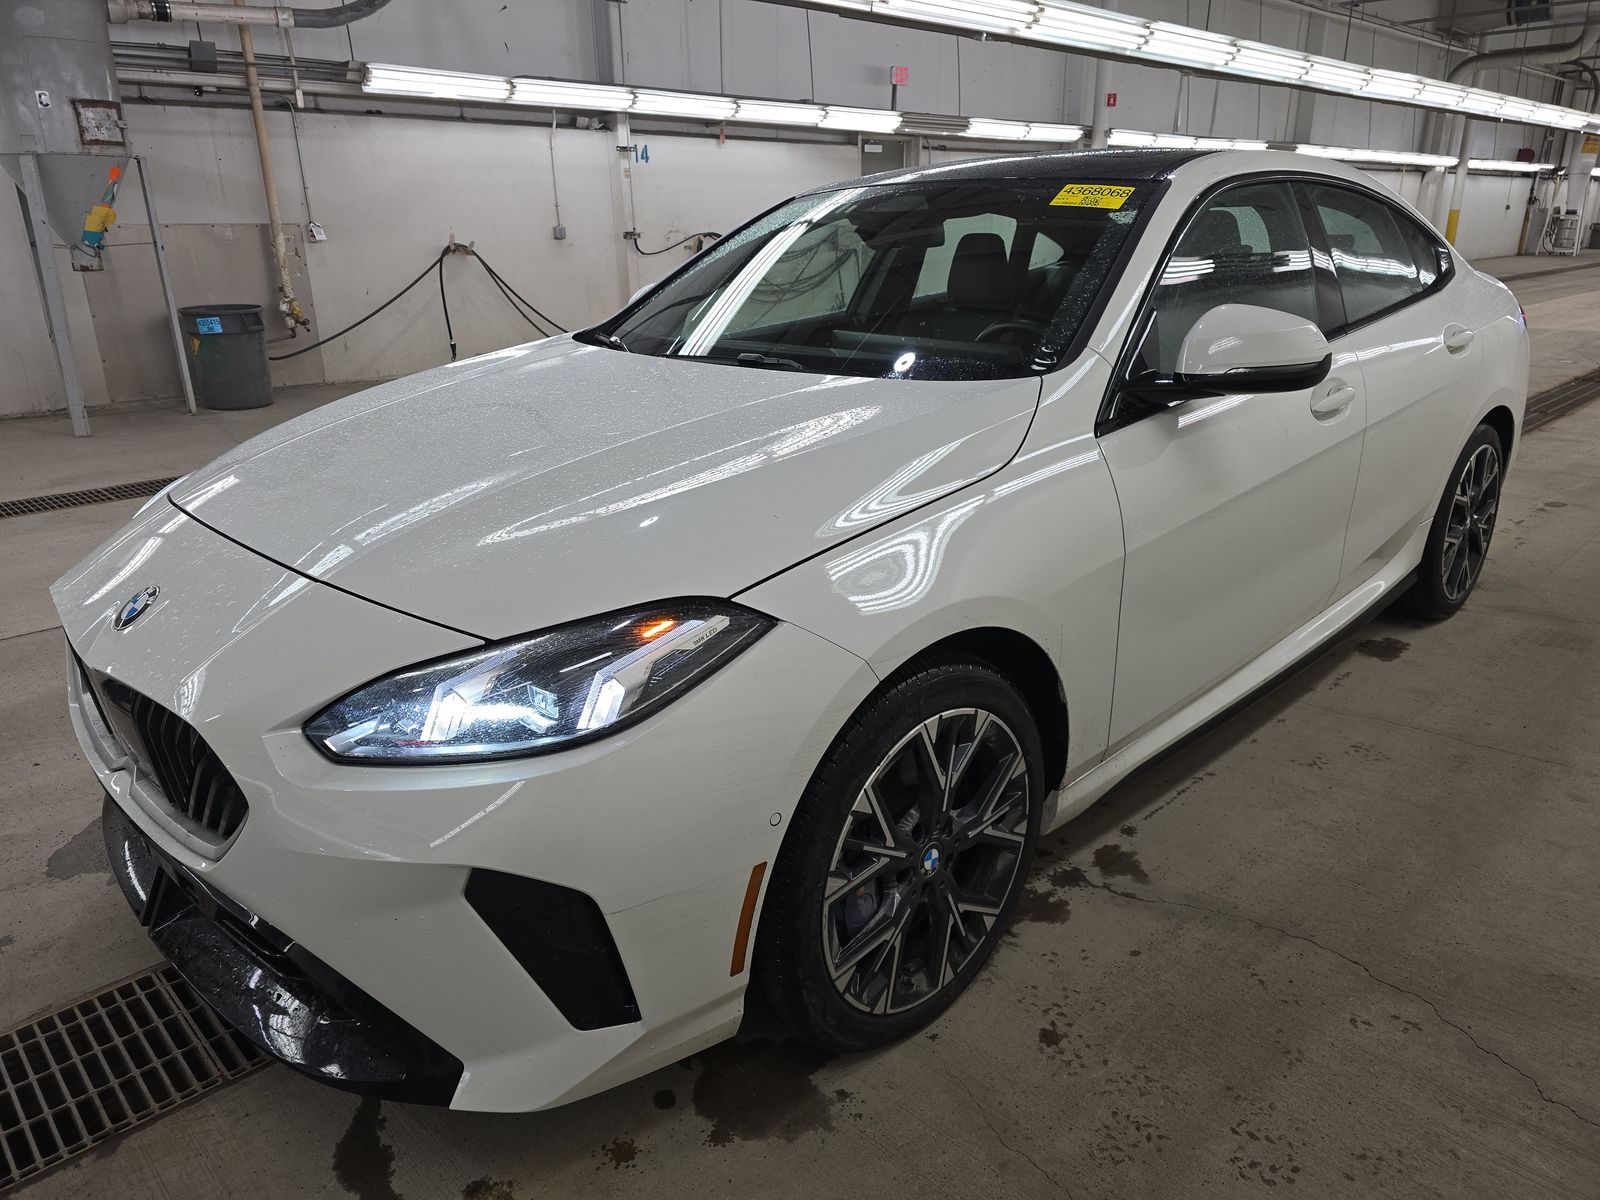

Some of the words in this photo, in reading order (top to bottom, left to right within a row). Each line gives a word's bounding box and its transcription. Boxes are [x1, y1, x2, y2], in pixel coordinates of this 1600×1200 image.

[38, 92, 50, 107] C
[634, 144, 650, 163] 14
[1063, 186, 1131, 198] 4368068
[705, 627, 718, 638] LED
